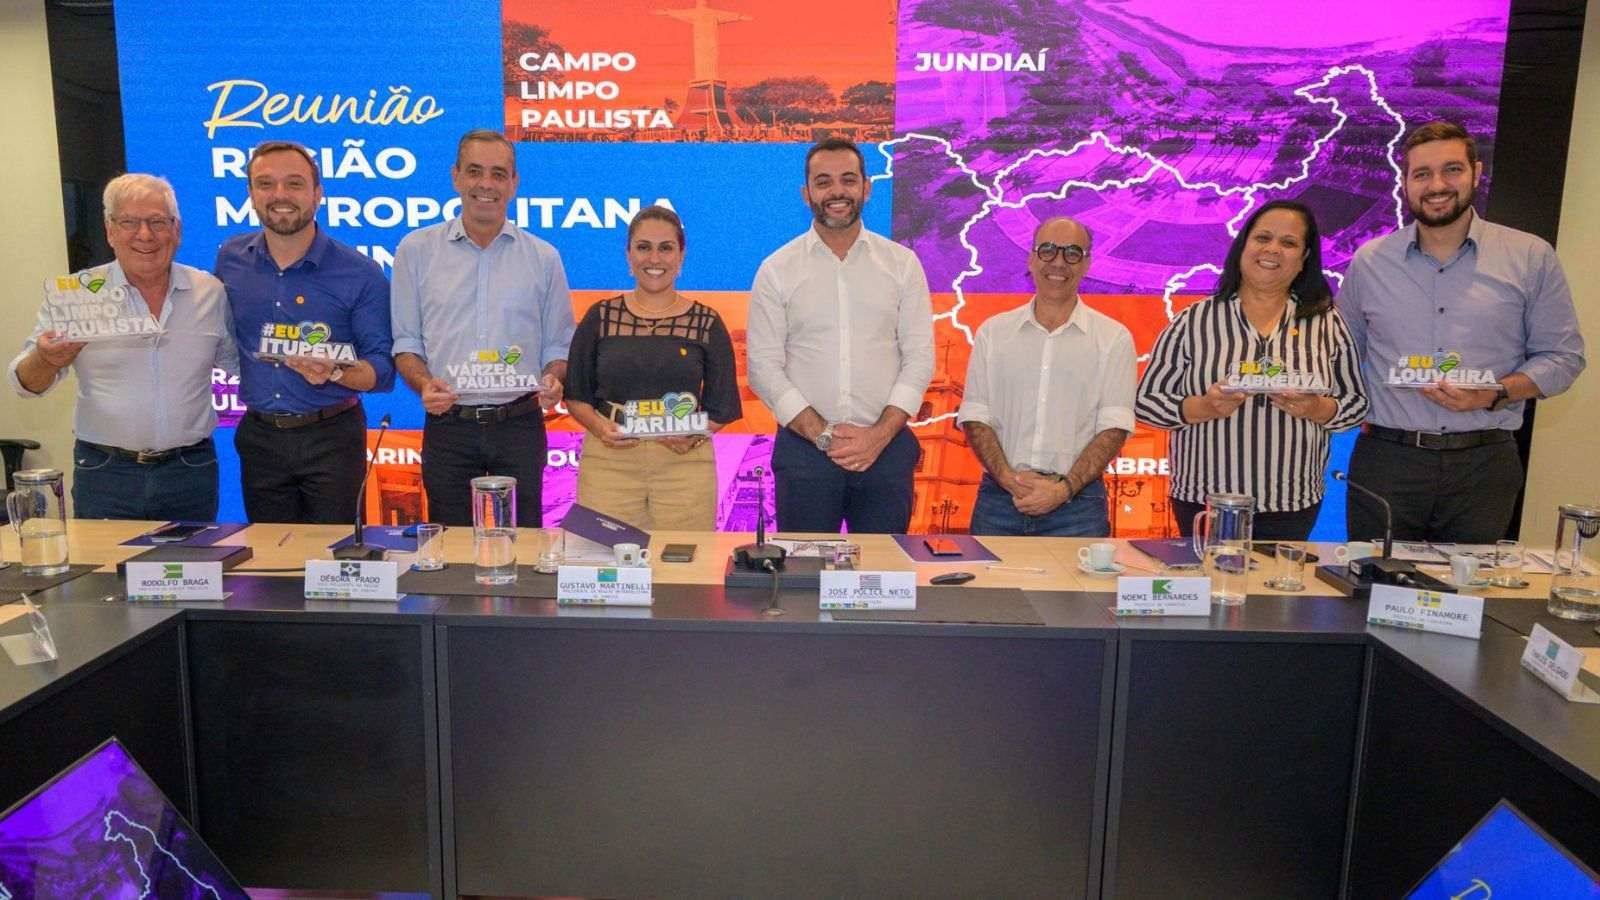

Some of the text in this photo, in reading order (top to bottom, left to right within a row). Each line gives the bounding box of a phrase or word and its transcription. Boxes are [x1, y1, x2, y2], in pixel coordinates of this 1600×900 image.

[518, 52, 637, 72] CAMPO
[913, 48, 1050, 72] JUNDIAÍ
[520, 81, 620, 100] LIMPO
[203, 79, 445, 140] Reunião
[520, 109, 674, 129] PAULISTA
[211, 139, 417, 179] RIÃO
[50, 303, 120, 320] LIMPO
[54, 316, 161, 337] PAULISTA
[262, 322, 300, 339] #EU
[260, 337, 358, 361] ITUPEVA
[446, 361, 517, 377] VÁRZEA
[1398, 354, 1433, 368] #EU
[457, 374, 539, 388] PAULISTA
[1388, 367, 1497, 384] LOUVEIRA
[624, 400, 665, 416] #EU
[620, 412, 709, 434] JARINU
[183, 578, 209, 586] BRAGA
[560, 582, 650, 590] GUSTAVO MARTINELLI
[889, 588, 911, 596] NETO
[1122, 593, 1148, 601] NOEMI
[1385, 604, 1415, 615] PAULO
